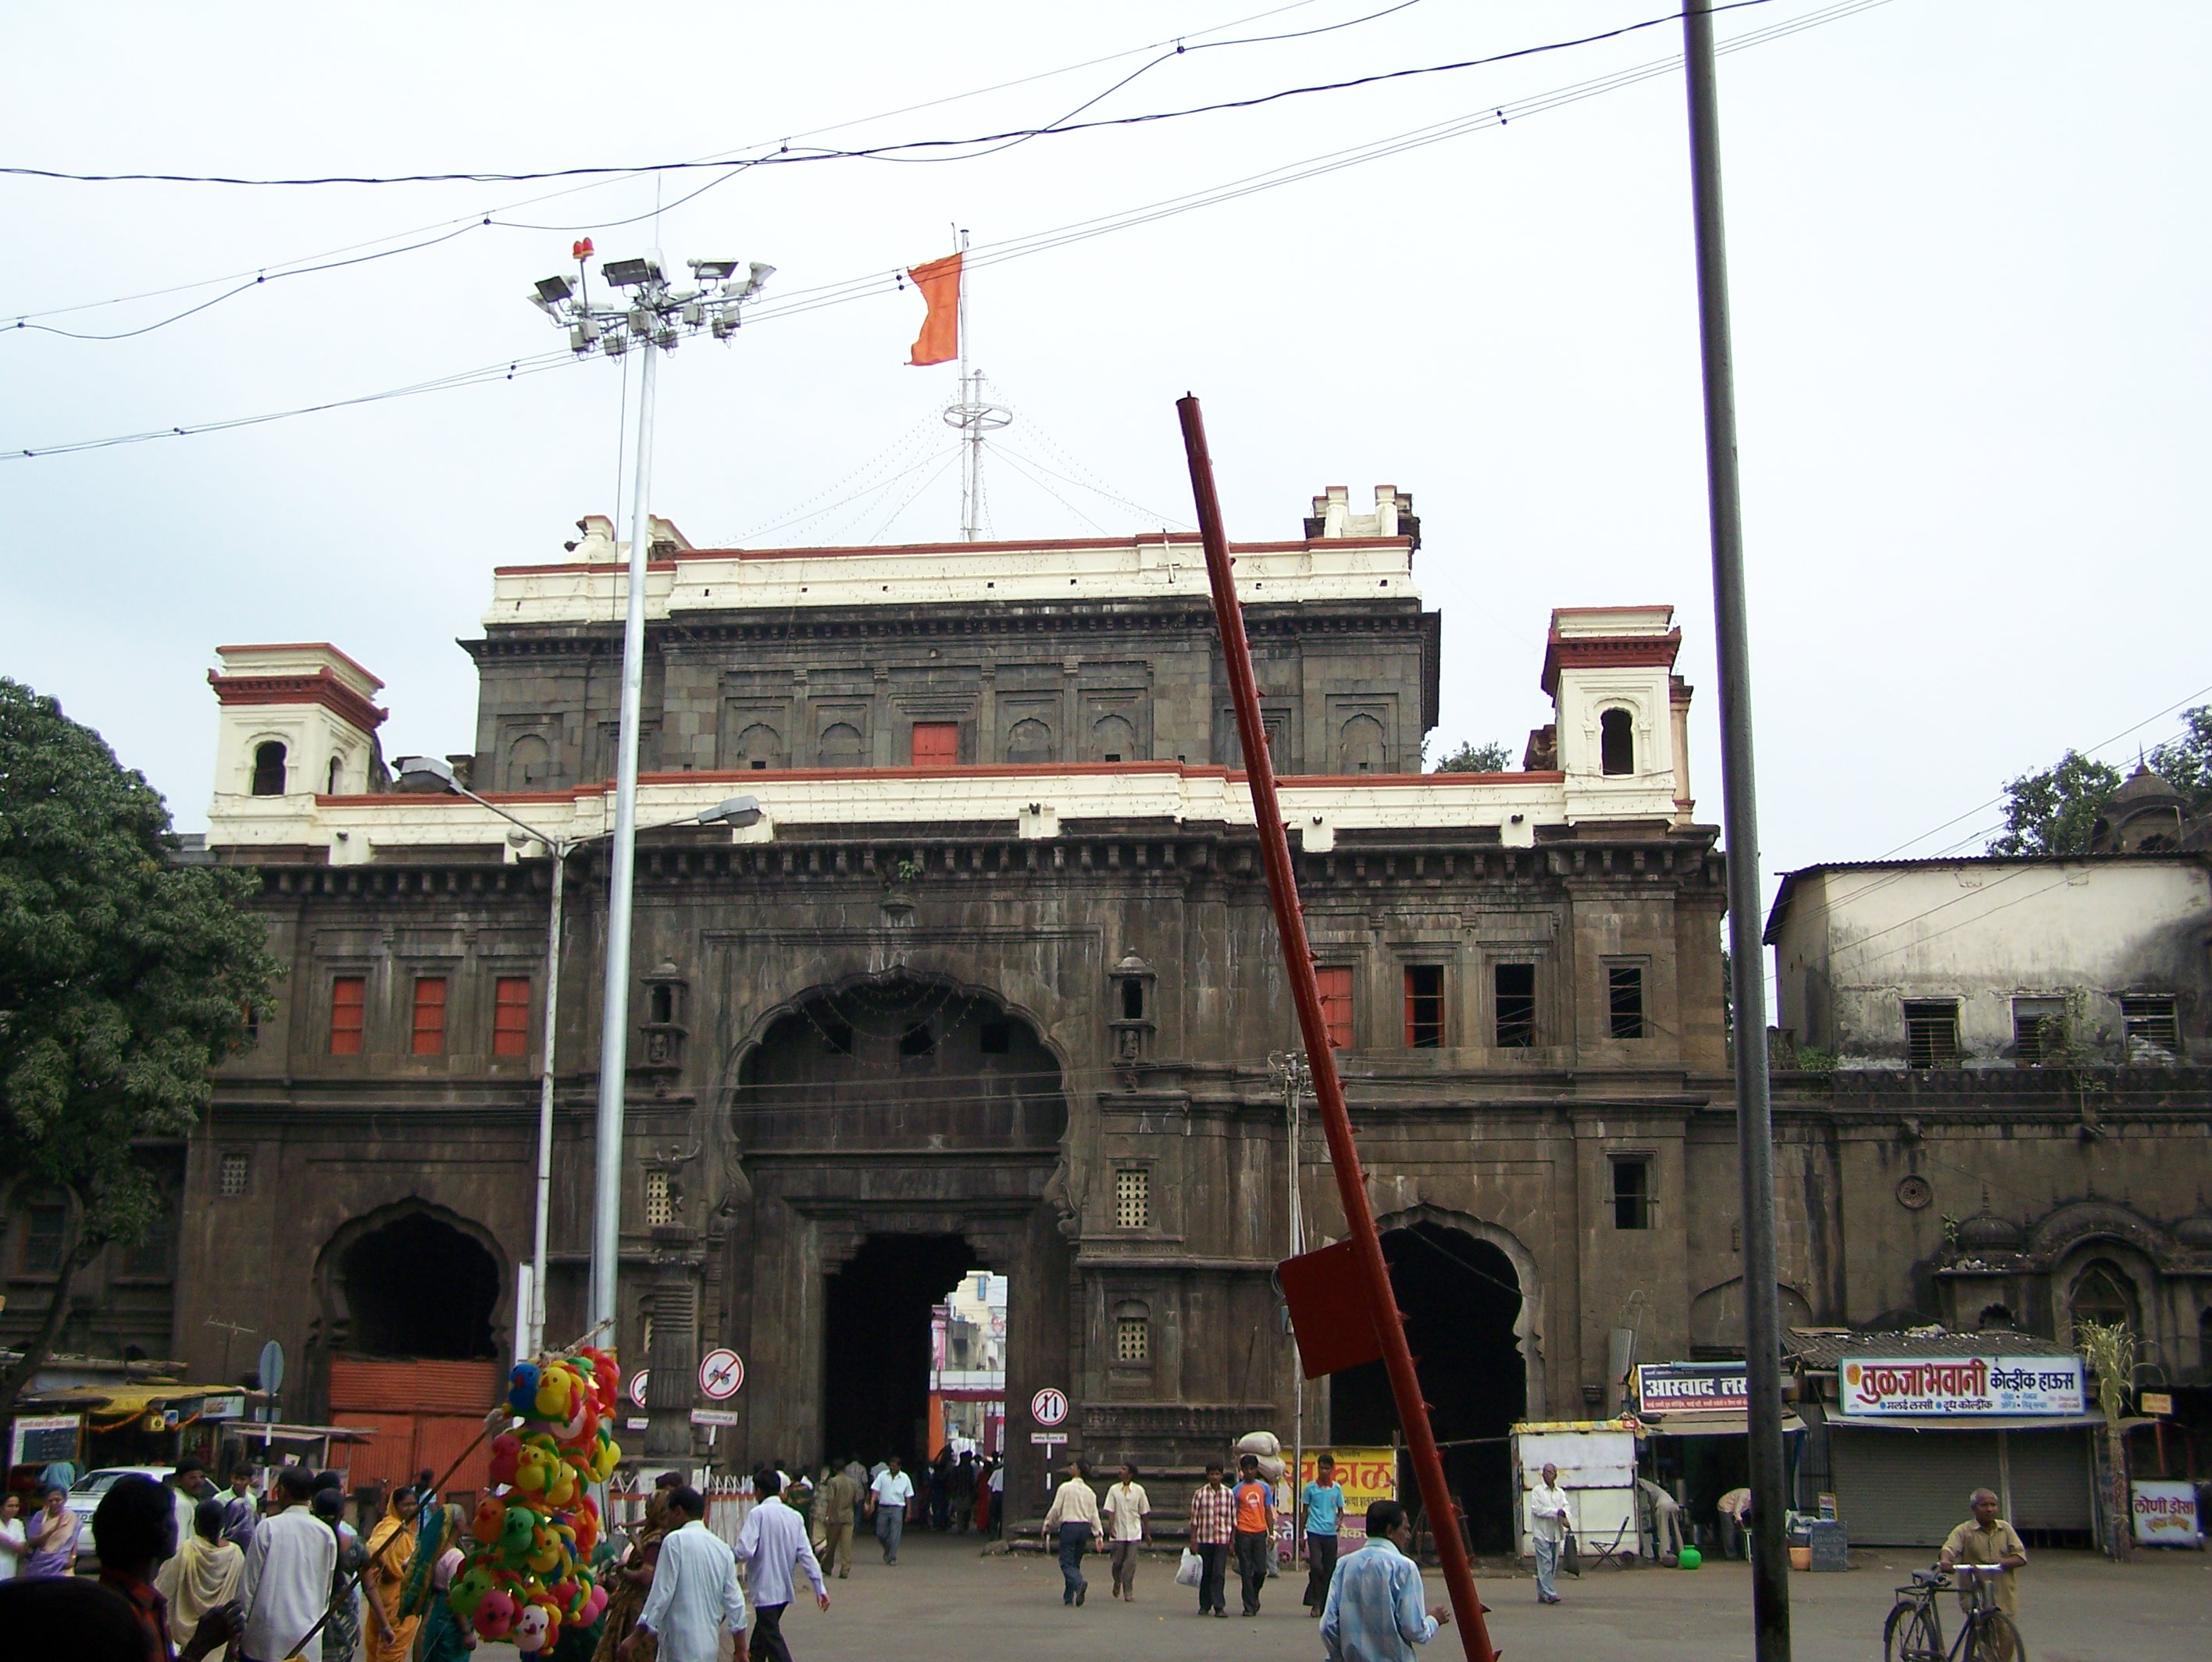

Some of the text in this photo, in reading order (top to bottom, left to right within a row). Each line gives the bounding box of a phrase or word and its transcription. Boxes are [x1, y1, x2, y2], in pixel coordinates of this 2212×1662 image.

[1645, 1378, 1715, 1396] आस्वाद
[1856, 1357, 1987, 1404] तुळजाभवानी
[2038, 1372, 2075, 1392] हाऊस
[1910, 1398, 1933, 1410] लस्सी
[2132, 1495, 2195, 1515] लोणी डोसा
